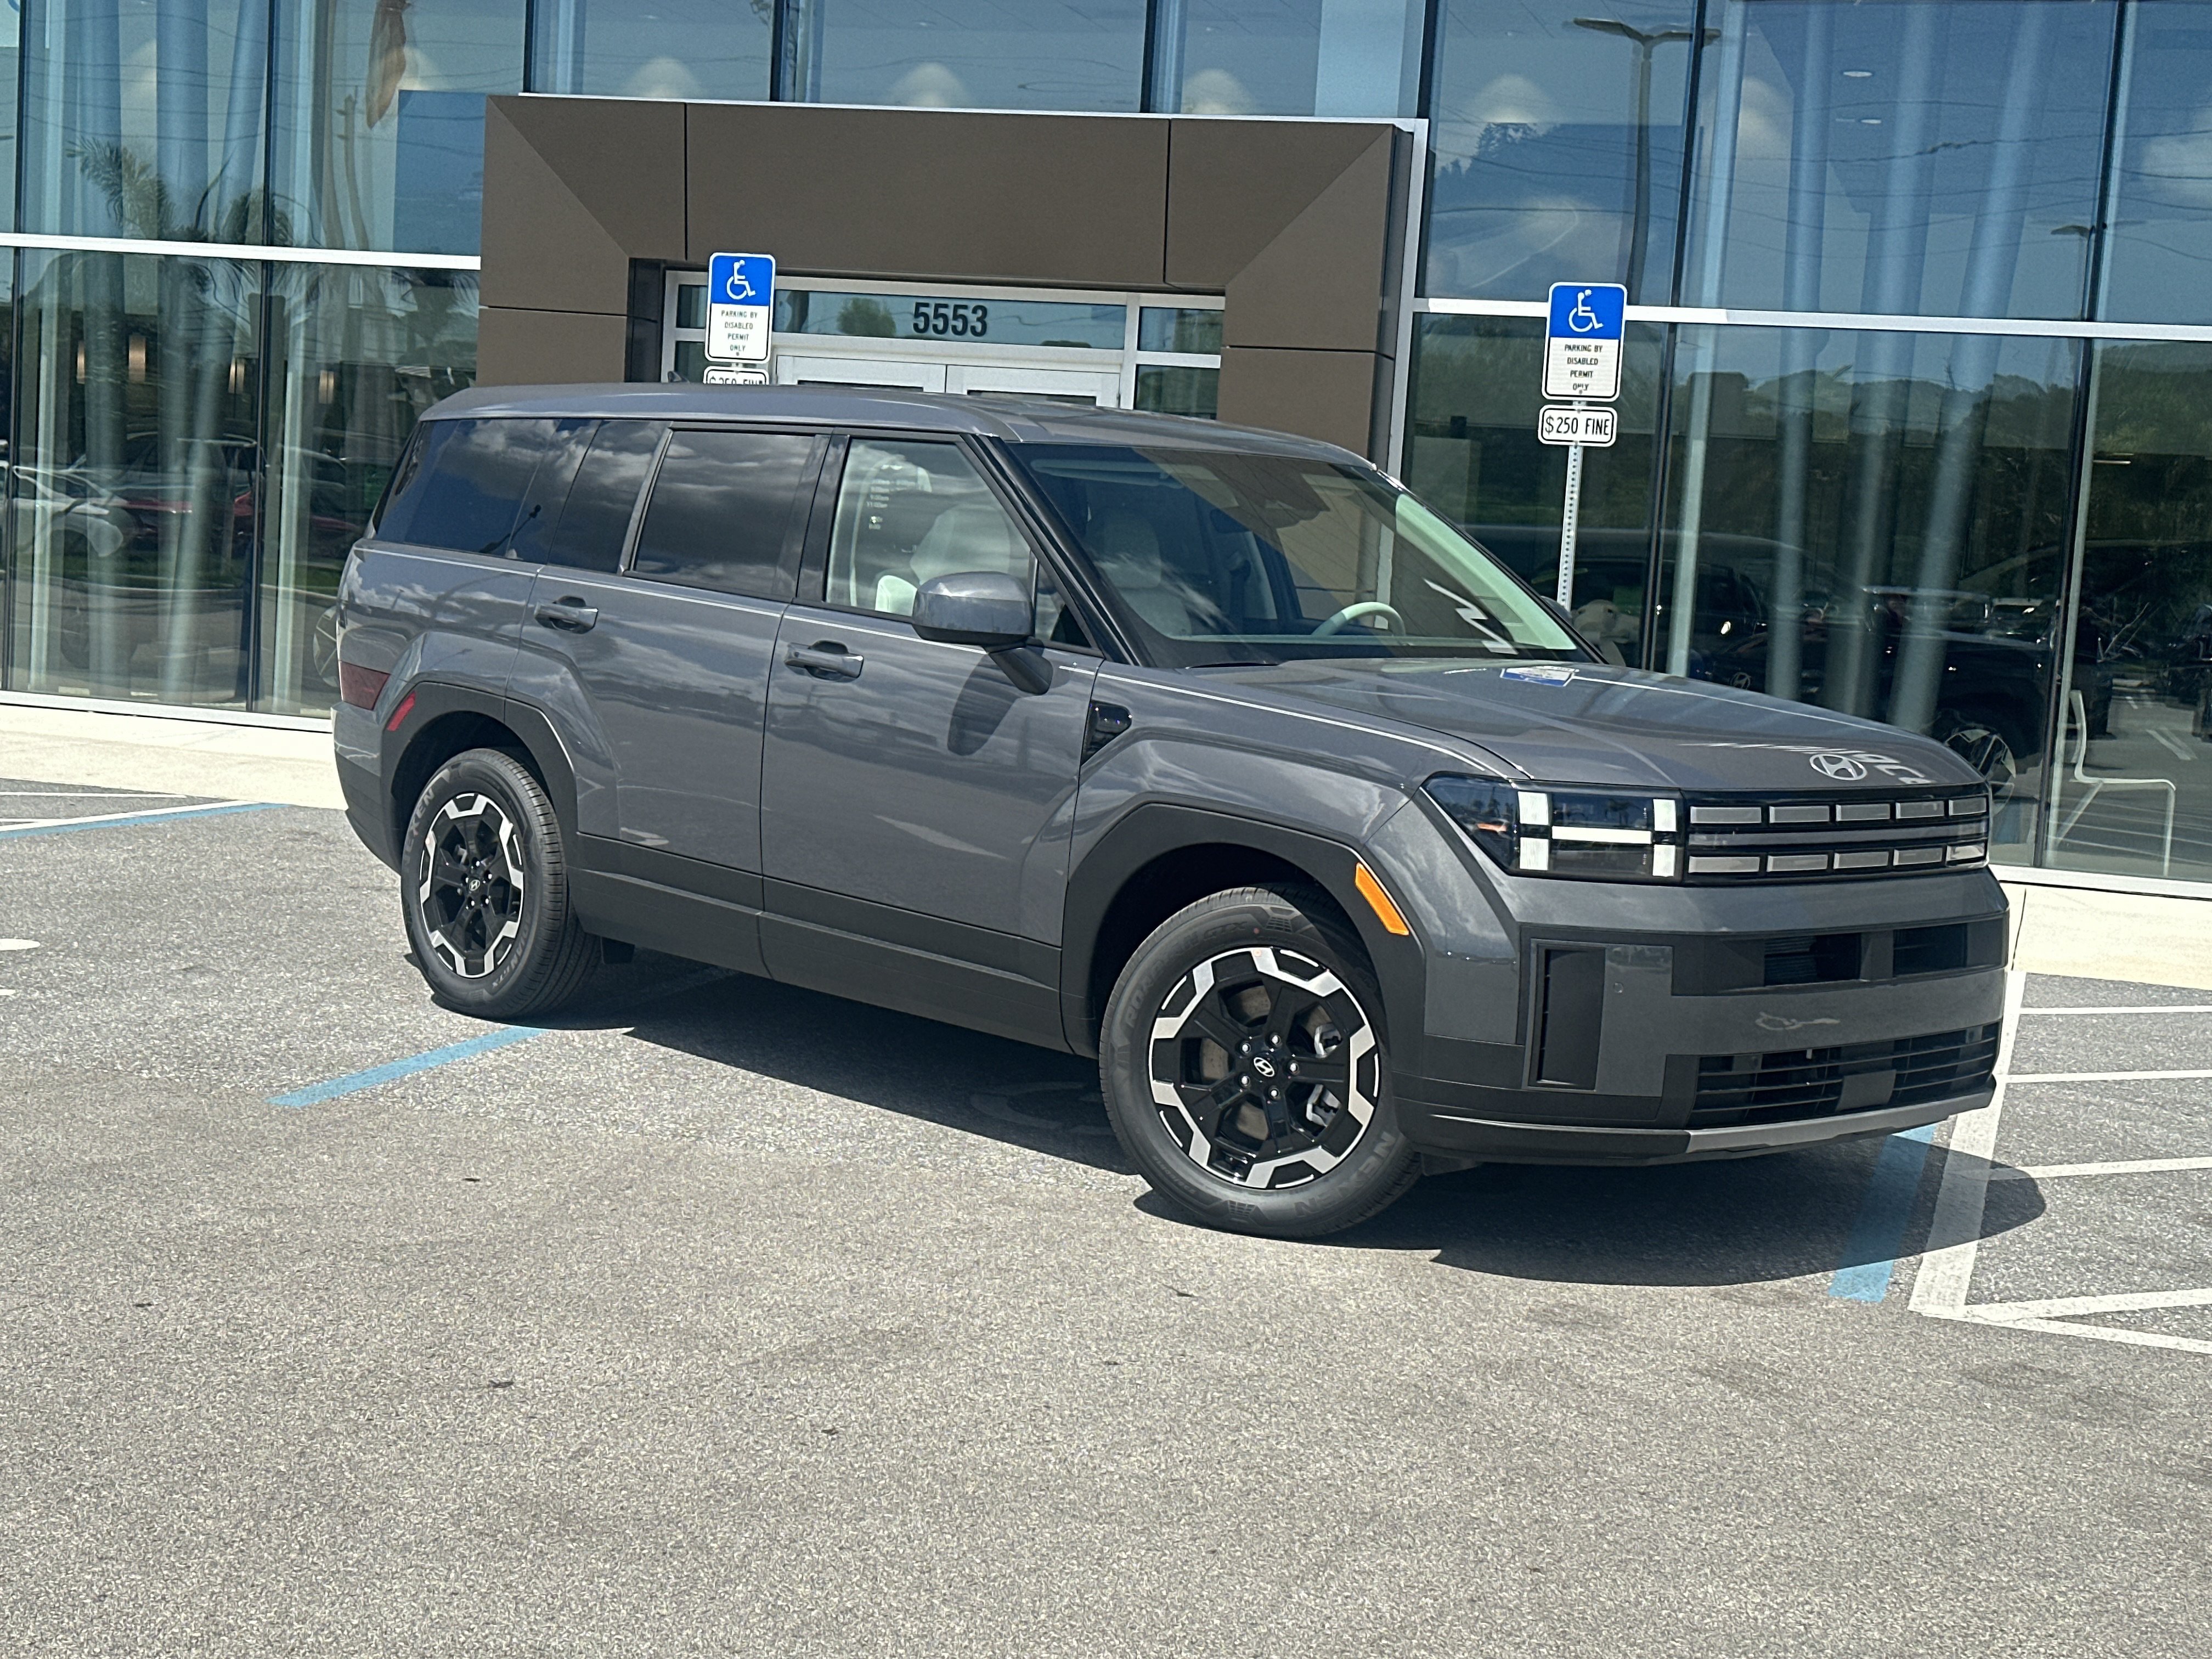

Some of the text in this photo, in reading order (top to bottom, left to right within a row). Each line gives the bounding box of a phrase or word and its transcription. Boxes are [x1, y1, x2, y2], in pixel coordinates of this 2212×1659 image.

[913, 302, 988, 337] 5553
[1564, 344, 1592, 352] PARKING
[1567, 357, 1599, 365] DISABLED
[1545, 415, 1610, 436] $250 FINE
[402, 787, 435, 871] NEXEN
[1294, 1131, 1397, 1218] NEXEN
